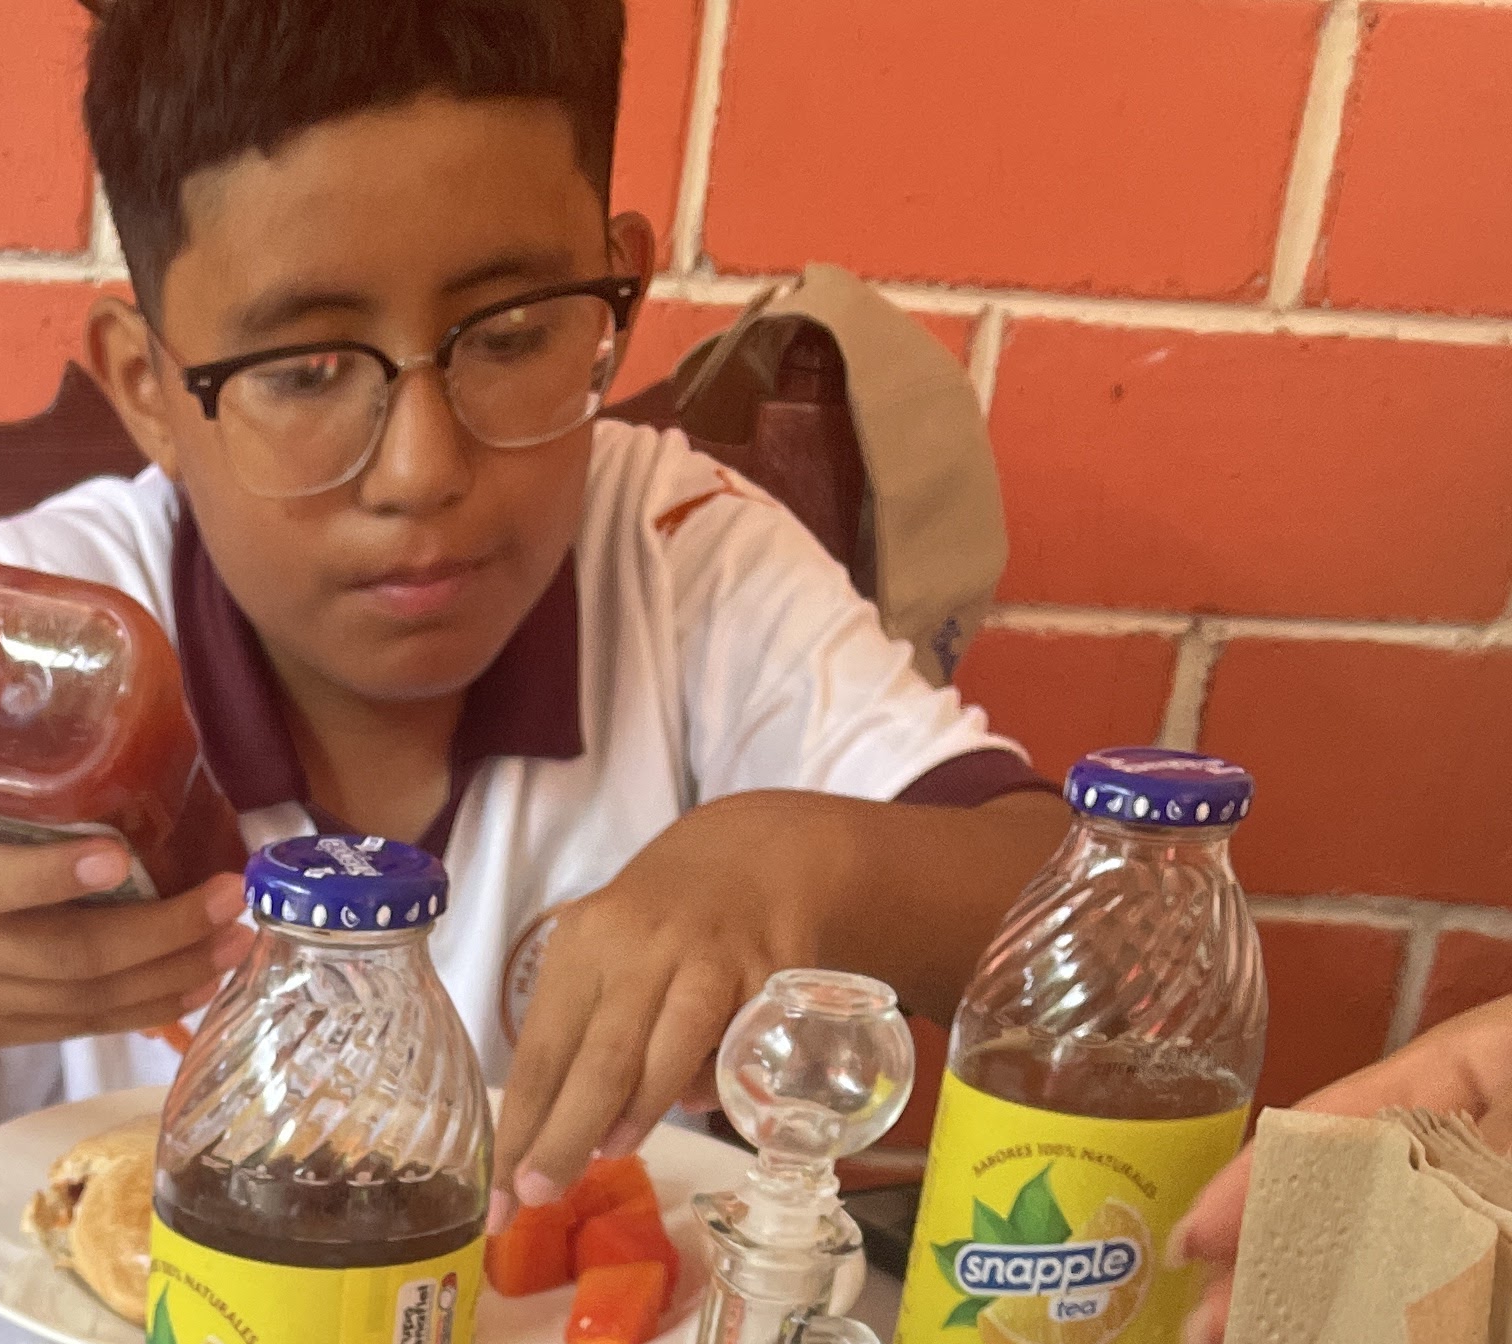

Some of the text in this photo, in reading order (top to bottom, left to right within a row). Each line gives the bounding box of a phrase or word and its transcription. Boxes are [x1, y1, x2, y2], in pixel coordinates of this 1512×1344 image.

[972, 1142, 1159, 1201] SABORES 100% NATURALES
[963, 1238, 1131, 1296] snapple
[1056, 1299, 1098, 1320] tea
